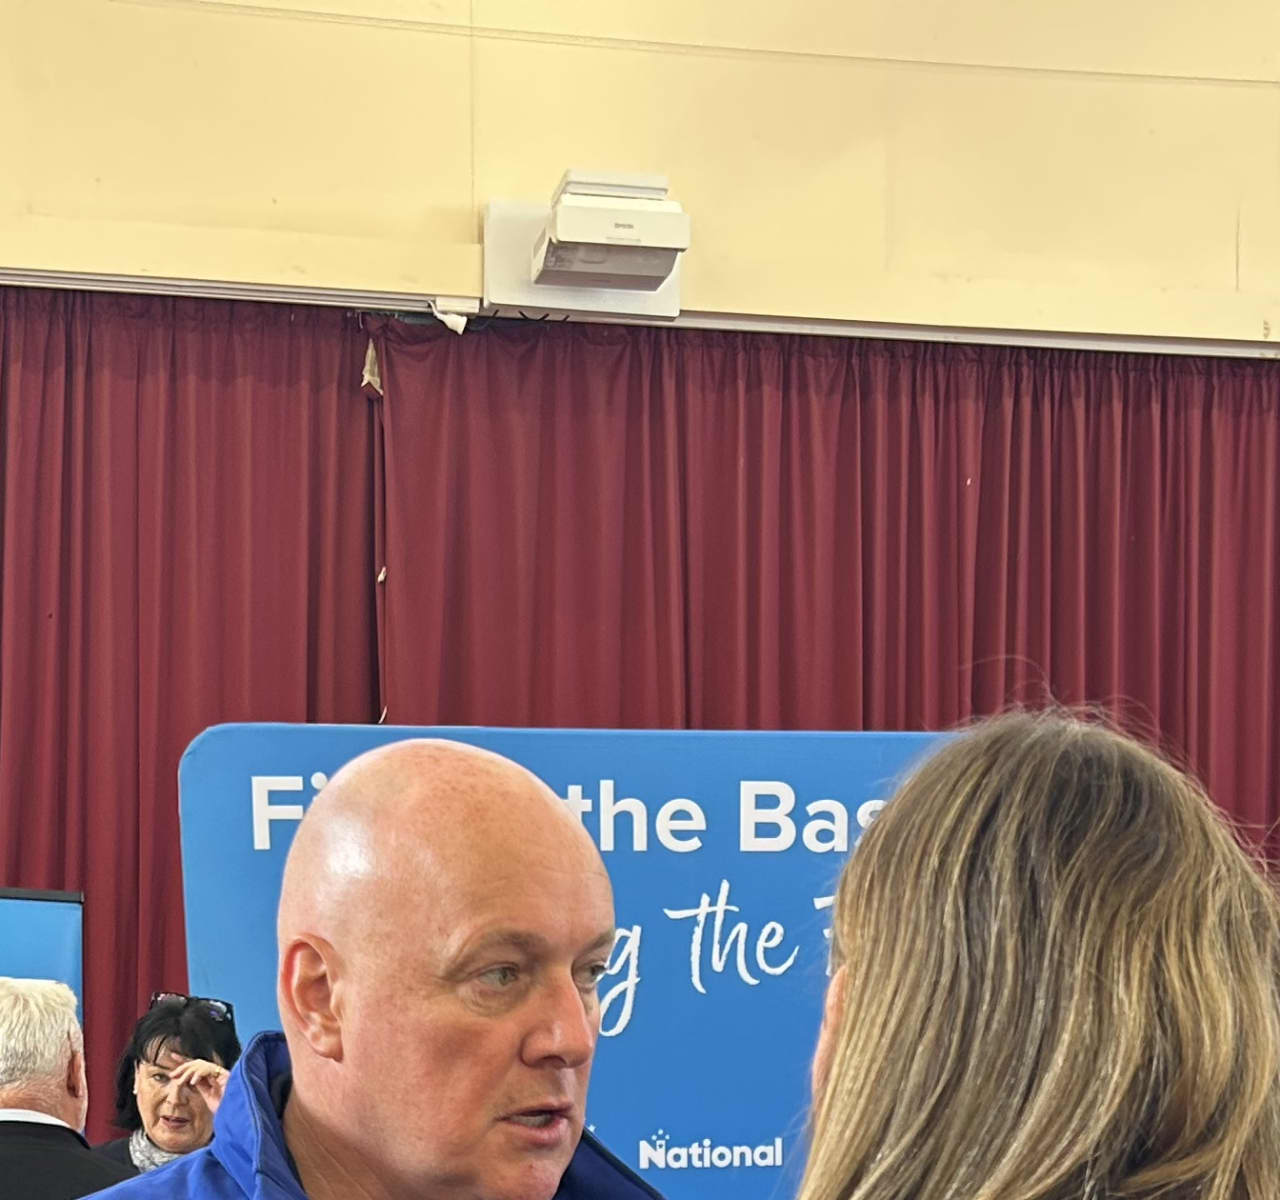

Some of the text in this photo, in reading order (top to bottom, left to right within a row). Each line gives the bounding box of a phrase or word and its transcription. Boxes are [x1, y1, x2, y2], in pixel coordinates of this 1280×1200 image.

[561, 779, 706, 852] the
[663, 879, 800, 994] the
[639, 1136, 783, 1169] National
